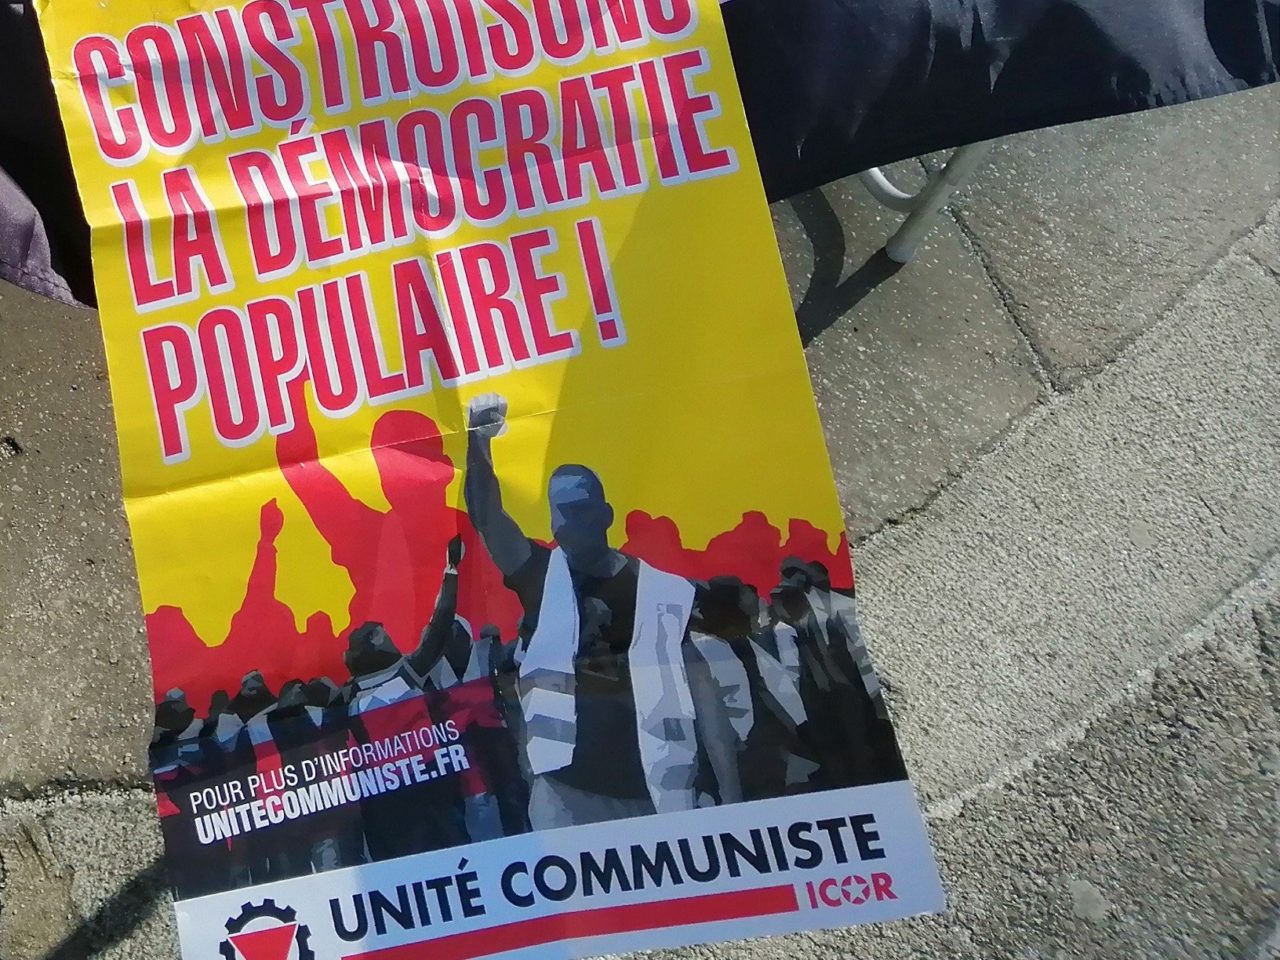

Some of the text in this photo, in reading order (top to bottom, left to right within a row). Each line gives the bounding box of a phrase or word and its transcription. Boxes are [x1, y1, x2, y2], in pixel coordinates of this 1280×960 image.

[110, 48, 739, 313] LA DÉMOCRATIE
[138, 218, 629, 464] POPULAIRE !
[189, 720, 461, 813] POUR PLUS D'INFORMATIONS
[194, 743, 471, 846] UNITECOMMUNISTE.FR
[329, 813, 888, 944] UNITÉ COMMUNISTE
[805, 873, 899, 912] ICOR
